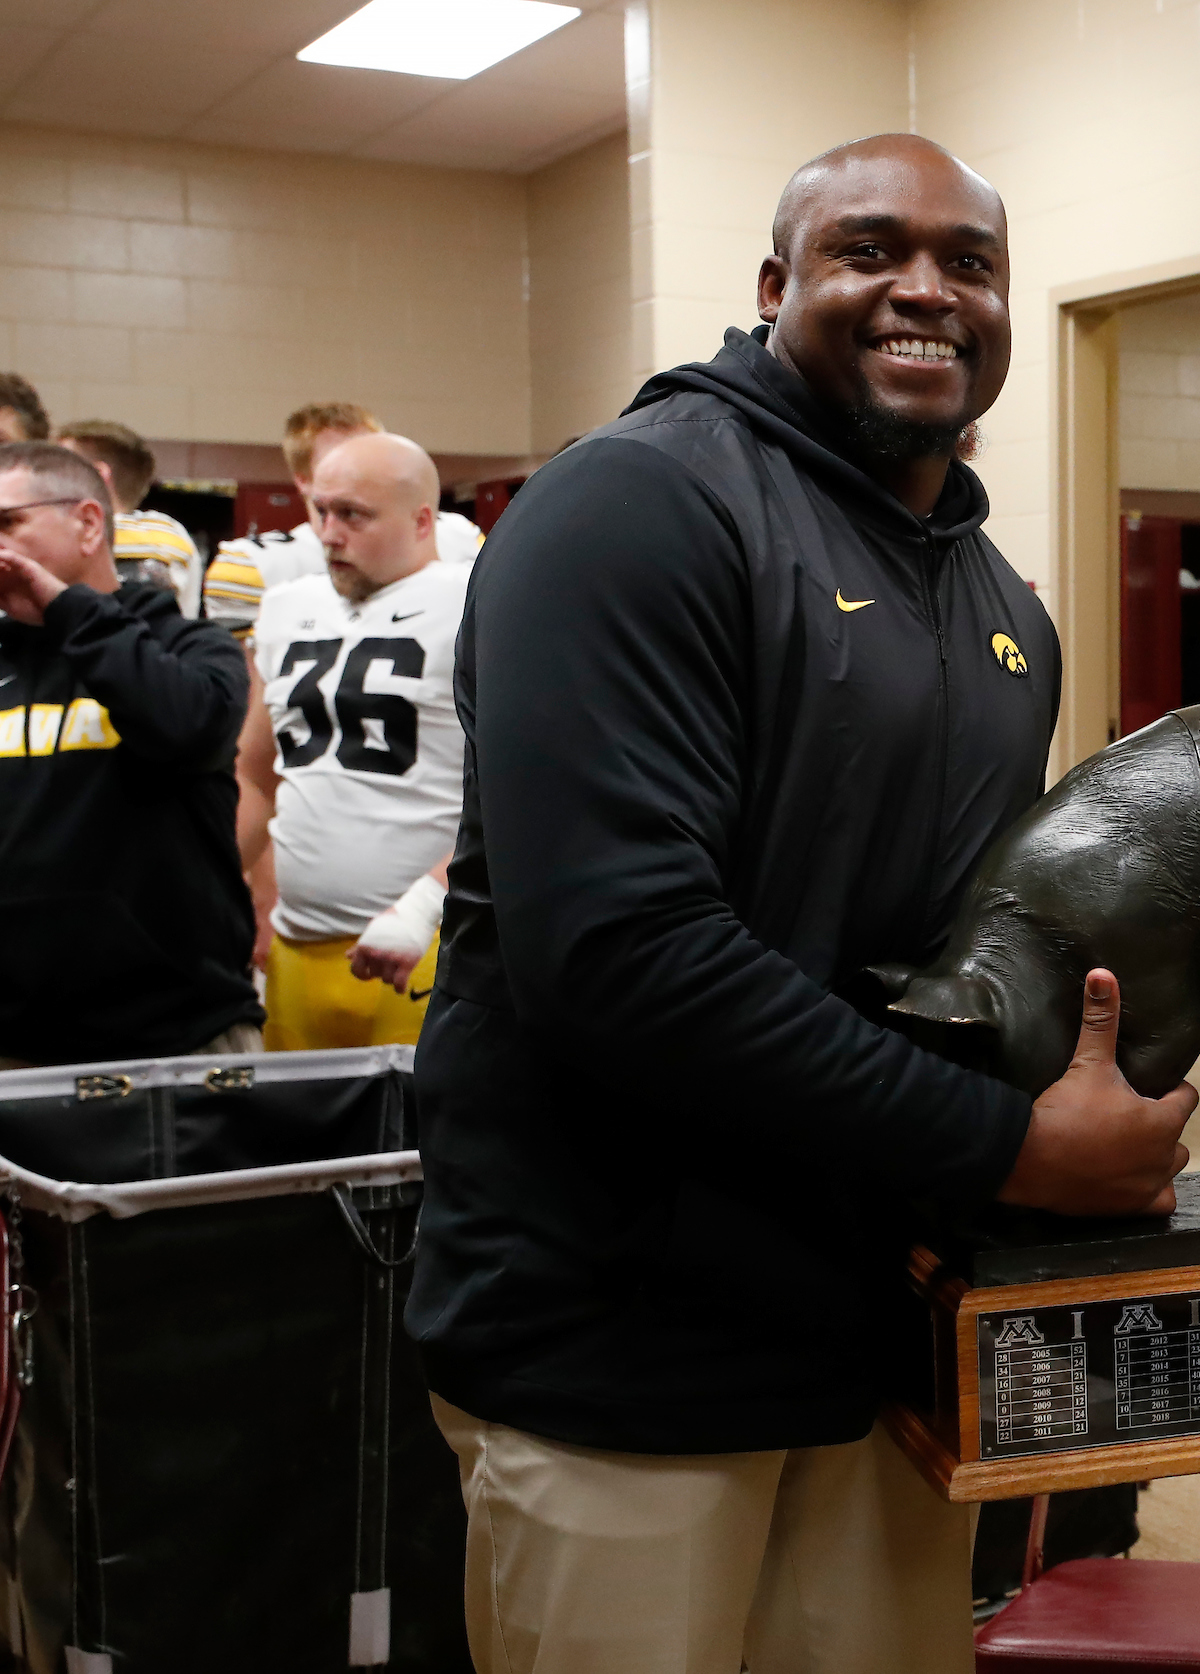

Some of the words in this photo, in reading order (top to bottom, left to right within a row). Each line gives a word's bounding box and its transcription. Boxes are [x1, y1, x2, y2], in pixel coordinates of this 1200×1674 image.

[277, 637, 426, 776] 36
[1118, 1341, 1127, 1349] 13
[1150, 1336, 1168, 1345] 2012
[1191, 1333, 1200, 1341] 31
[998, 1354, 1007, 1363] 28
[1032, 1349, 1051, 1359] 2005
[1074, 1345, 1083, 1353] 52
[1120, 1354, 1125, 1362] 7
[1150, 1349, 1168, 1358] 2013
[1191, 1345, 1200, 1354] 23
[999, 1367, 1008, 1376] 34
[1032, 1362, 1051, 1372] 2006
[1074, 1358, 1083, 1367] 24
[1118, 1367, 1127, 1375] 51
[1151, 1362, 1169, 1371] 2014
[1192, 1358, 1200, 1366] 14
[999, 1380, 1008, 1388] 16
[1032, 1375, 1051, 1385] 2007
[1074, 1371, 1083, 1380] 21
[1118, 1379, 1127, 1388] 35
[1151, 1374, 1169, 1384] 2015
[1192, 1371, 1200, 1379] 40
[1001, 1393, 1006, 1401] 0
[1032, 1388, 1051, 1398] 2008
[1075, 1384, 1084, 1393] 55
[1121, 1392, 1126, 1400] 7
[1151, 1387, 1169, 1397] 2016
[1192, 1384, 1200, 1392] 14
[1001, 1406, 1007, 1414] 0
[1033, 1401, 1052, 1411] 2009
[1075, 1397, 1084, 1406] 12
[1120, 1405, 1129, 1413] 10
[1152, 1400, 1170, 1410] 2017
[1000, 1419, 1009, 1427] 27
[1033, 1414, 1052, 1423] 2010
[1075, 1410, 1085, 1418] 24
[1152, 1412, 1170, 1422] 2018
[1000, 1432, 1009, 1440] 22
[1033, 1427, 1052, 1437] 2011
[1075, 1423, 1084, 1432] 21
